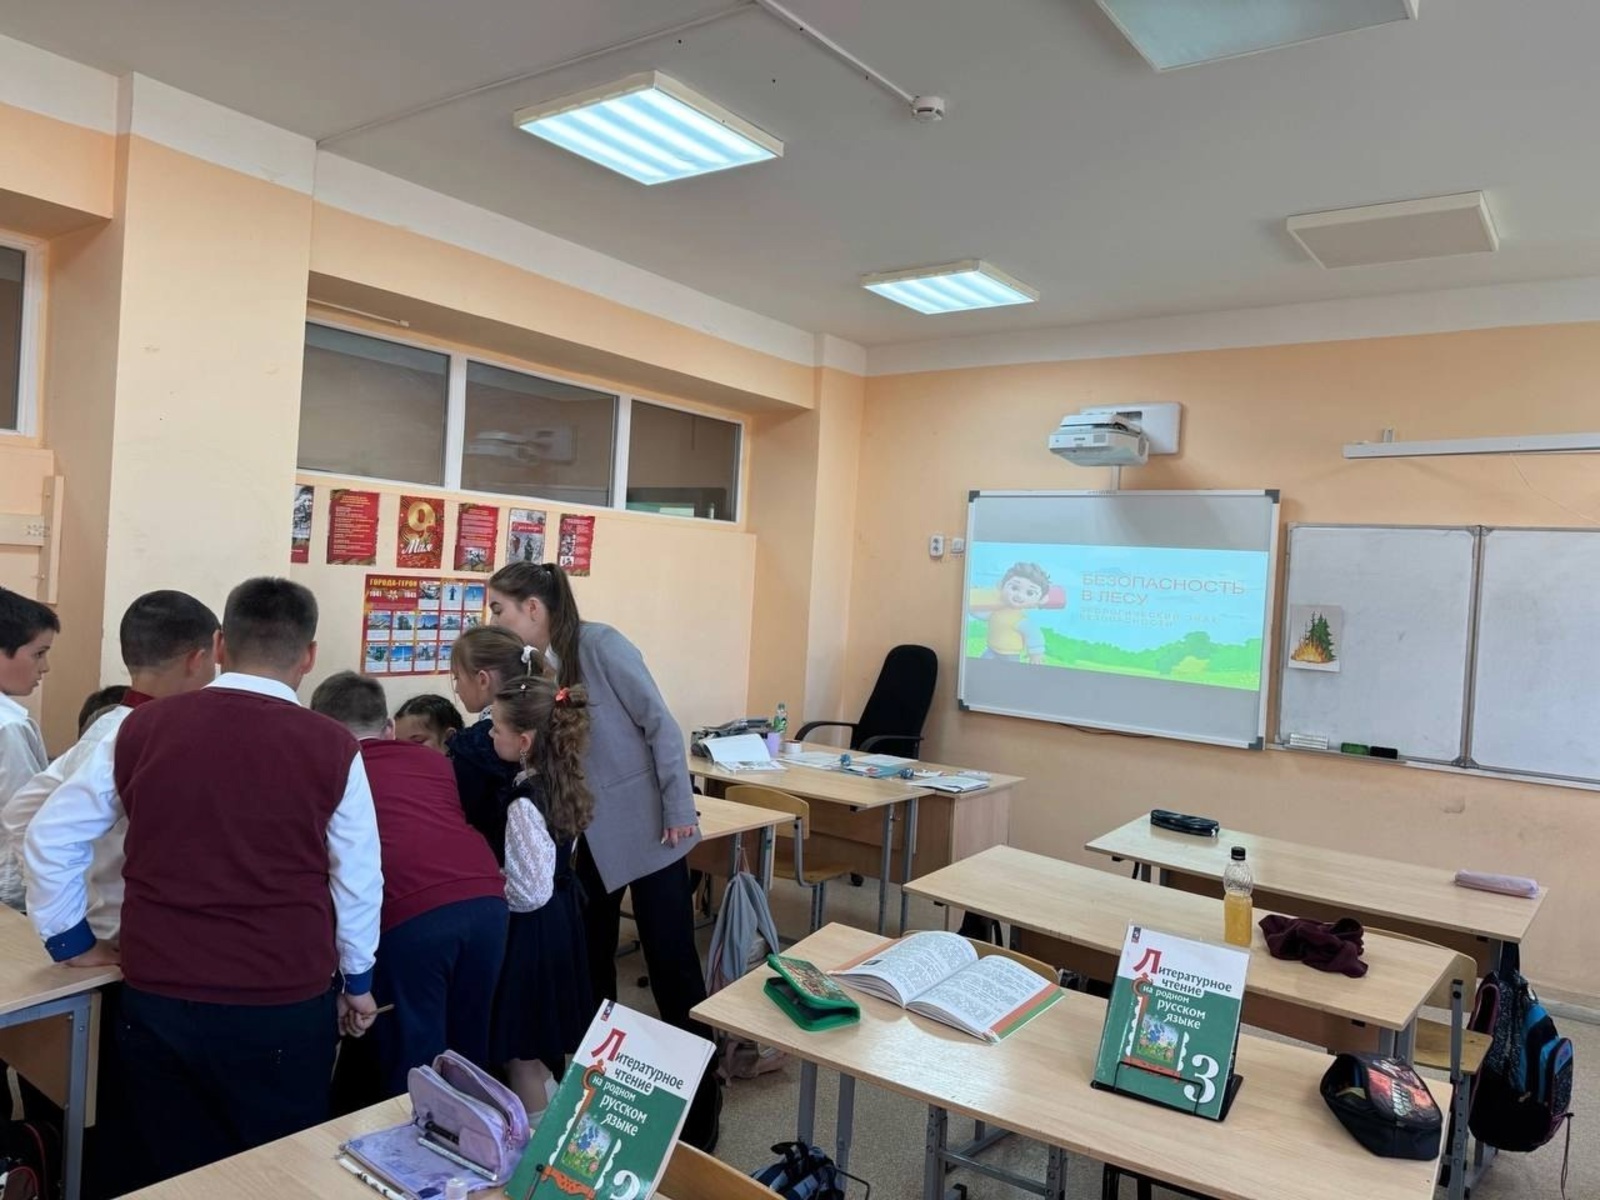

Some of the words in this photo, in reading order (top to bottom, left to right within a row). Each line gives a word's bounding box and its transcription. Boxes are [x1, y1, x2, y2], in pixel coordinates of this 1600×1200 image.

[1082, 572, 1245, 595] БЕЗОПАСНОСТЬ
[1081, 589, 1092, 601] В
[1098, 590, 1148, 606] ЛЕСУ
[1133, 948, 1232, 993] Литературное
[1143, 985, 1154, 994] на
[1155, 988, 1190, 1004] родном
[1161, 977, 1203, 996] чтение
[1157, 999, 1206, 1020] русском
[1163, 1012, 1201, 1030] языке
[591, 1027, 684, 1090] Литературное
[592, 1075, 603, 1086] на
[603, 1082, 636, 1102] родном
[614, 1067, 652, 1093] чтение
[1183, 1054, 1220, 1104] 3
[600, 1094, 648, 1124] русском
[600, 1113, 639, 1136] языке
